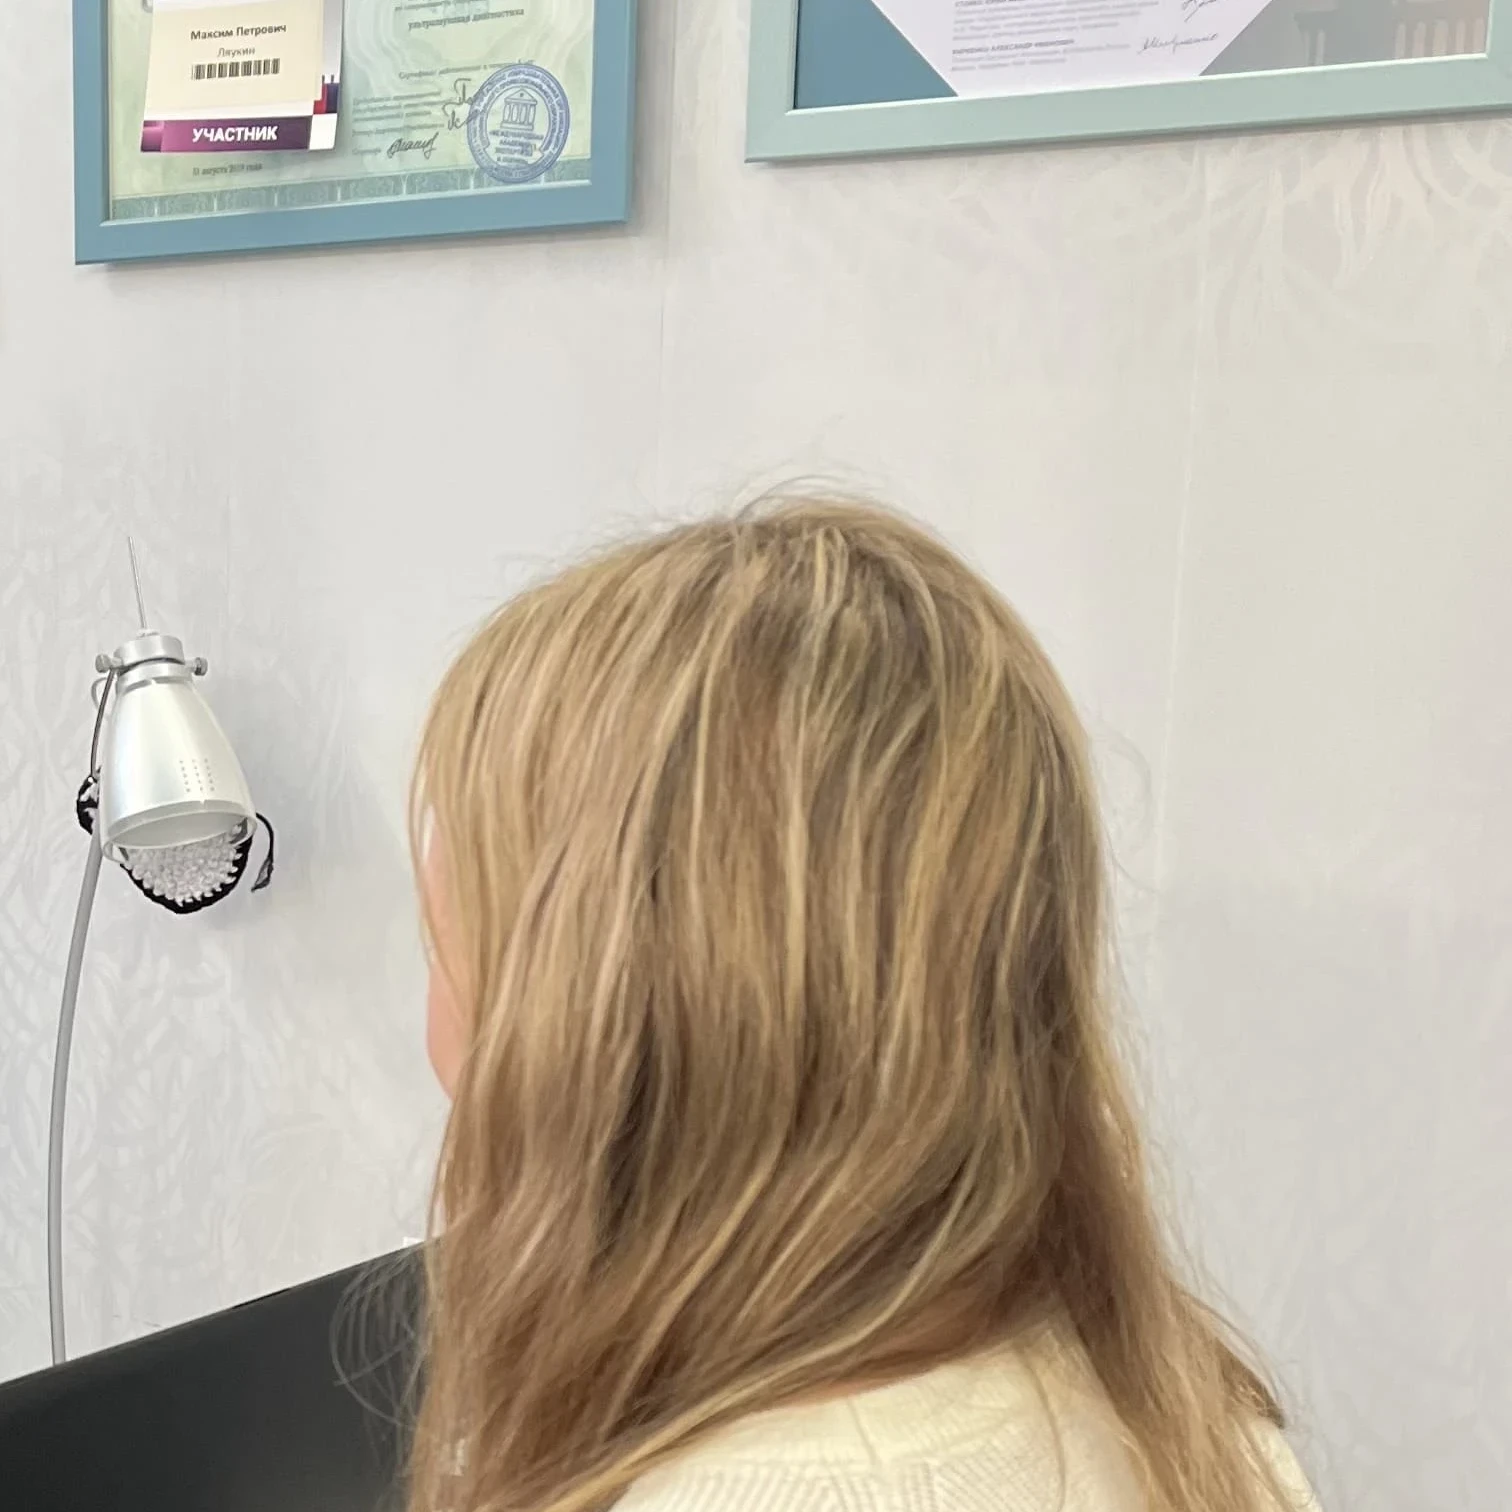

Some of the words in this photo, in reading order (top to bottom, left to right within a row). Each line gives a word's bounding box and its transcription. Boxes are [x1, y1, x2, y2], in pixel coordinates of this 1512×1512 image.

[190, 28, 234, 41] Максим
[236, 24, 287, 38] Петрович
[192, 125, 278, 143] УЧАСТНИК
